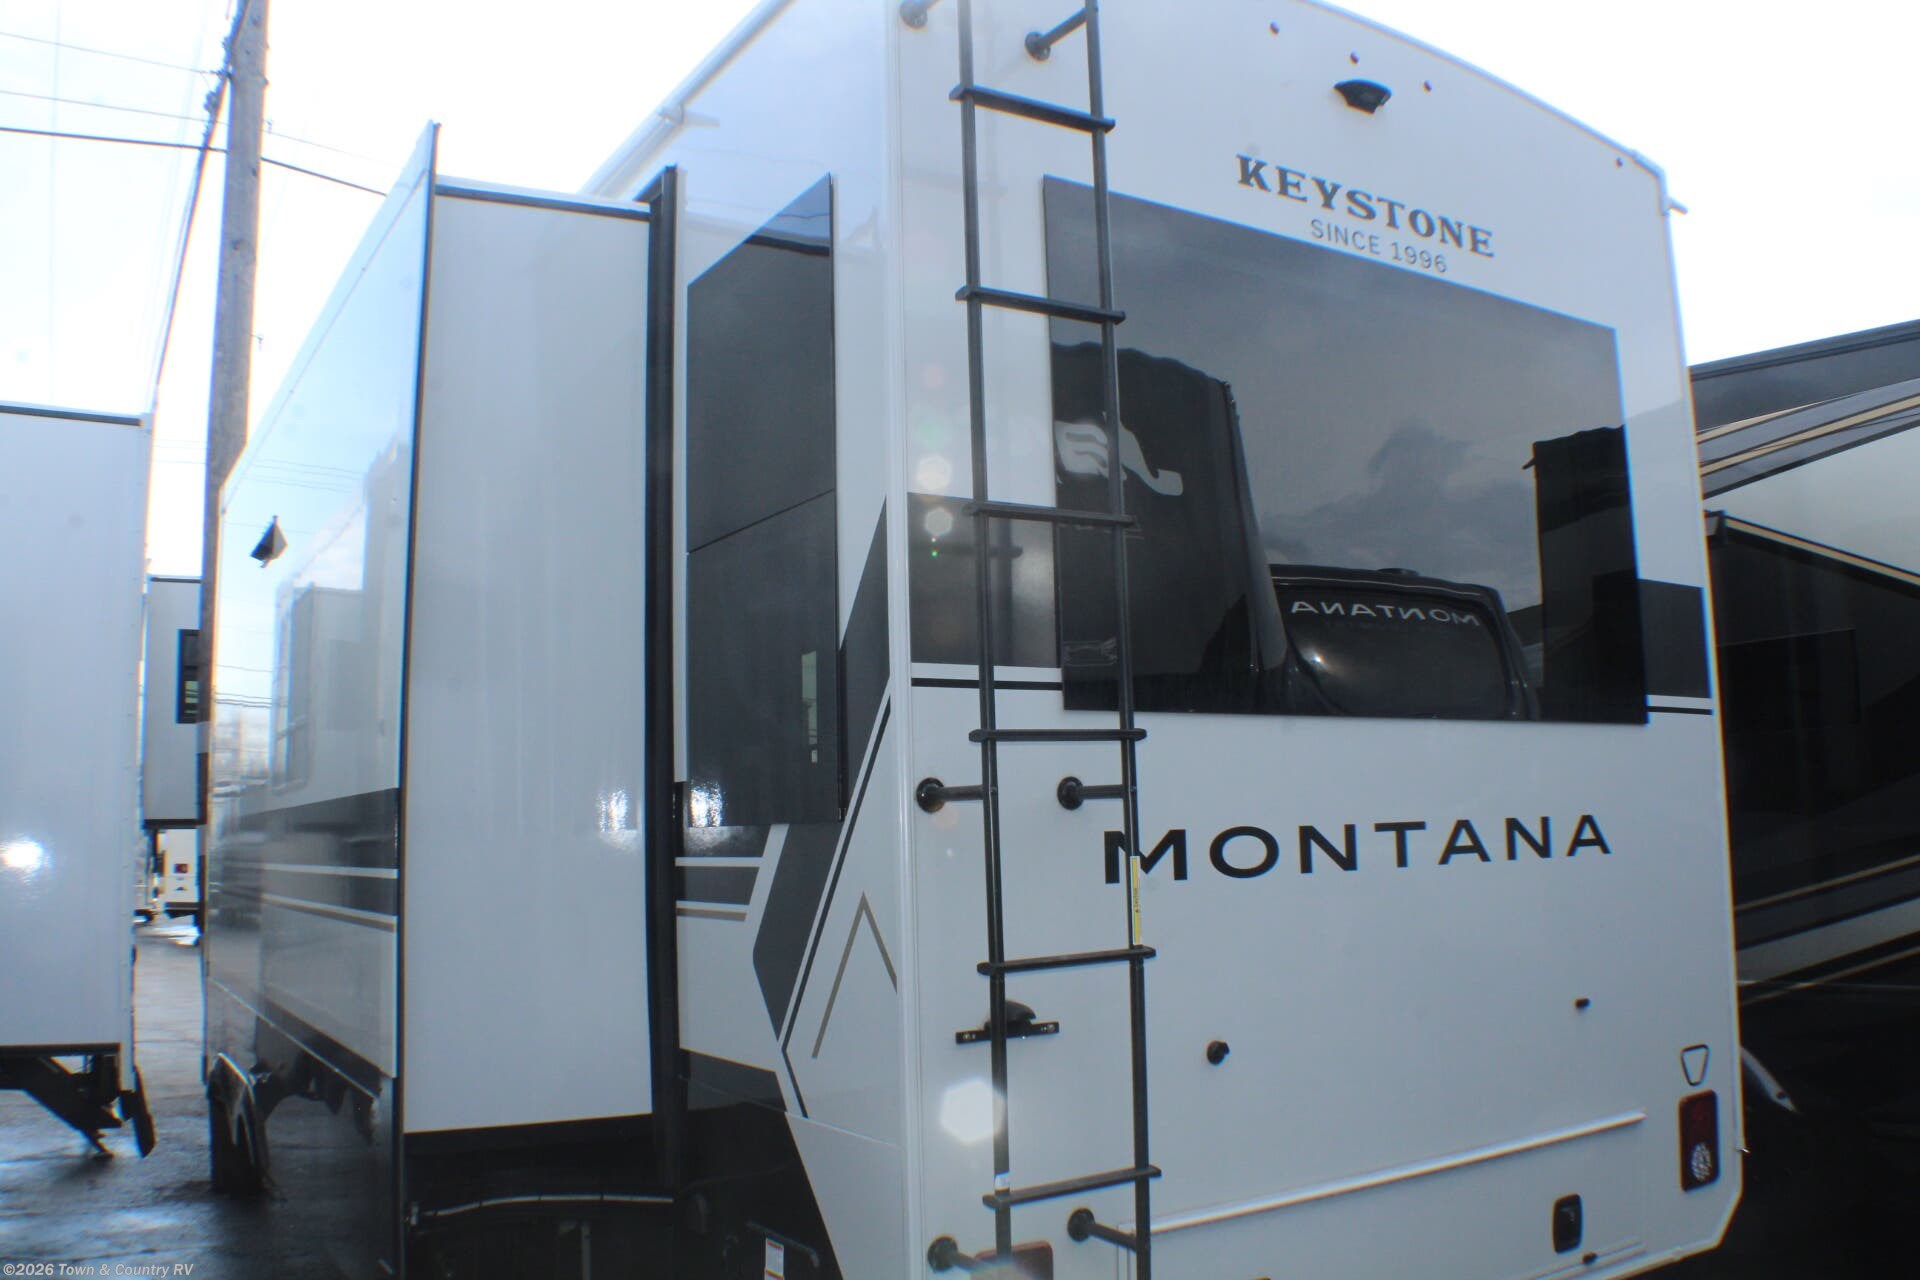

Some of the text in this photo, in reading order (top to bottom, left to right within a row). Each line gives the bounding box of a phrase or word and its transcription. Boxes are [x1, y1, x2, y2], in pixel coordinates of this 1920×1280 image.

[1236, 153, 1494, 258] KEYSTONE
[1310, 218, 1447, 273] SINCE 1996
[1103, 814, 1611, 884] MONTANA
